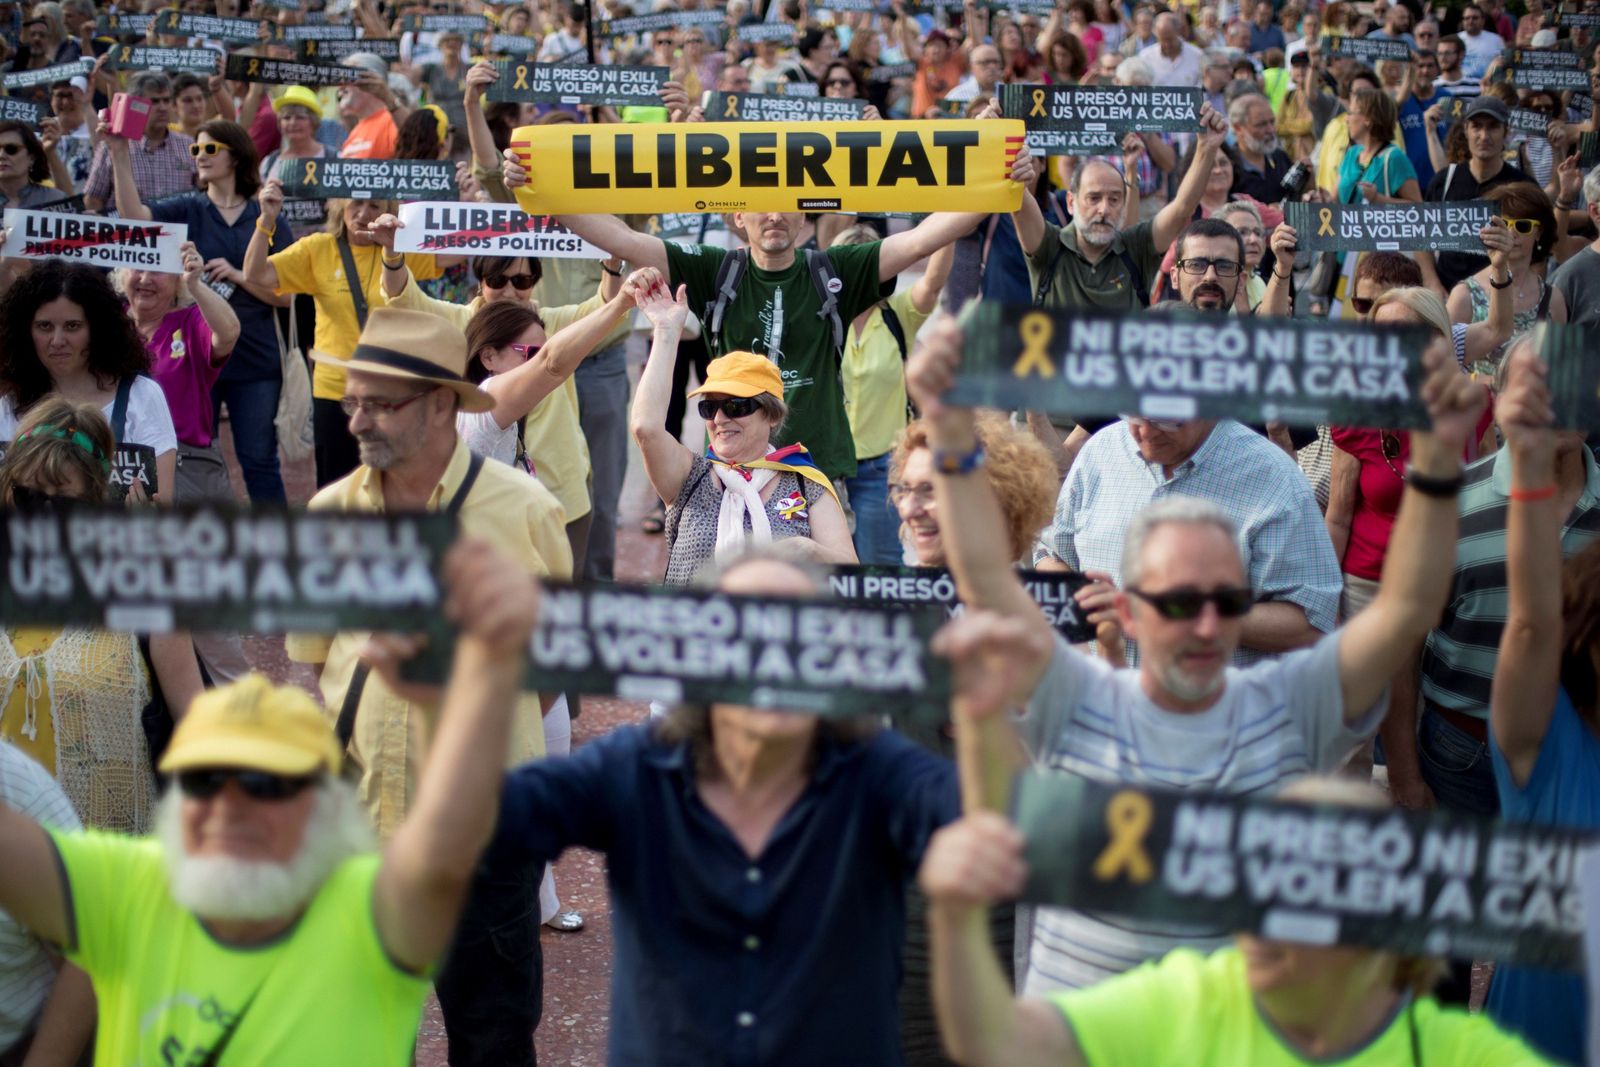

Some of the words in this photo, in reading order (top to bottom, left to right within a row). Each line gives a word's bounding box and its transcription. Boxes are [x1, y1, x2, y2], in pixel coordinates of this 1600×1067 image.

[535, 68, 549, 80] NI
[553, 67, 599, 82] PRESÓ
[603, 70, 617, 81] NI
[533, 81, 551, 92] US
[555, 81, 603, 94] VOLEM
[606, 83, 617, 94] A
[620, 83, 659, 95] CASA
[1054, 92, 1070, 105] NI
[1074, 89, 1127, 105] PRESÓ
[1131, 92, 1147, 105] NI
[1151, 93, 1194, 108] EXILI,
[744, 98, 758, 108] NI
[761, 97, 804, 112] PRESÓ
[807, 102, 821, 112] NI
[1052, 105, 1073, 119] US
[1077, 106, 1132, 119] VOLEM
[1136, 107, 1148, 119] A
[1152, 107, 1196, 120] CASA
[742, 110, 759, 120] US
[763, 110, 808, 121] VOLEM
[811, 113, 821, 121] A
[1068, 135, 1079, 146] A
[1081, 135, 1117, 146] CASA
[324, 163, 339, 174] NI
[343, 160, 390, 176] PRESÓ
[393, 165, 407, 175] NI
[572, 130, 979, 188] LLIBERTAT
[323, 176, 341, 187] US
[345, 176, 394, 189] VOLEM
[397, 178, 408, 189] A
[411, 177, 450, 190] CASA
[425, 208, 573, 234] LLIBERTA
[1342, 210, 1358, 223] NI
[1364, 207, 1419, 223] PRESÓ
[1424, 209, 1440, 222] NI
[26, 216, 162, 248] LLIBERTAT
[1341, 225, 1363, 238] US
[1367, 225, 1425, 238] VOLEM
[1431, 225, 1443, 237] A
[25, 241, 83, 257] PRESOS
[89, 246, 161, 265] POLÍTICS!
[424, 235, 491, 249] PRESOS
[500, 235, 582, 252] POLÍTICS!
[1071, 321, 1111, 351] NI
[1119, 319, 1247, 357] PRESÓ
[1256, 327, 1296, 360] NI
[1065, 353, 1117, 384] US
[1125, 355, 1257, 392] VOLEM
[1266, 363, 1296, 395] A
[1303, 365, 1410, 399] CASA
[108, 469, 150, 486] ASA
[7, 517, 61, 555] NI
[67, 514, 230, 557] PRESÓ
[235, 517, 289, 557] NI
[8, 559, 72, 597] US
[79, 559, 246, 598] VOLEM
[253, 560, 293, 599] A
[302, 559, 439, 601] CASA
[829, 576, 855, 597] NI
[864, 572, 955, 600] PRESÓ
[539, 593, 582, 626] NI
[590, 593, 739, 639] PRESÓ
[742, 604, 791, 641] NI
[530, 630, 591, 667] US
[597, 632, 750, 678] VOLEM
[752, 645, 796, 682] A
[798, 647, 926, 692] CASA
[1173, 803, 1233, 847] NI
[1240, 808, 1413, 871] PRESÓ
[1421, 834, 1479, 878] NI
[1484, 839, 1585, 888] EXI
[1164, 847, 1235, 896] US
[1246, 862, 1423, 919] VOLEM
[1429, 882, 1475, 923] A
[1483, 884, 1586, 932] CAS
